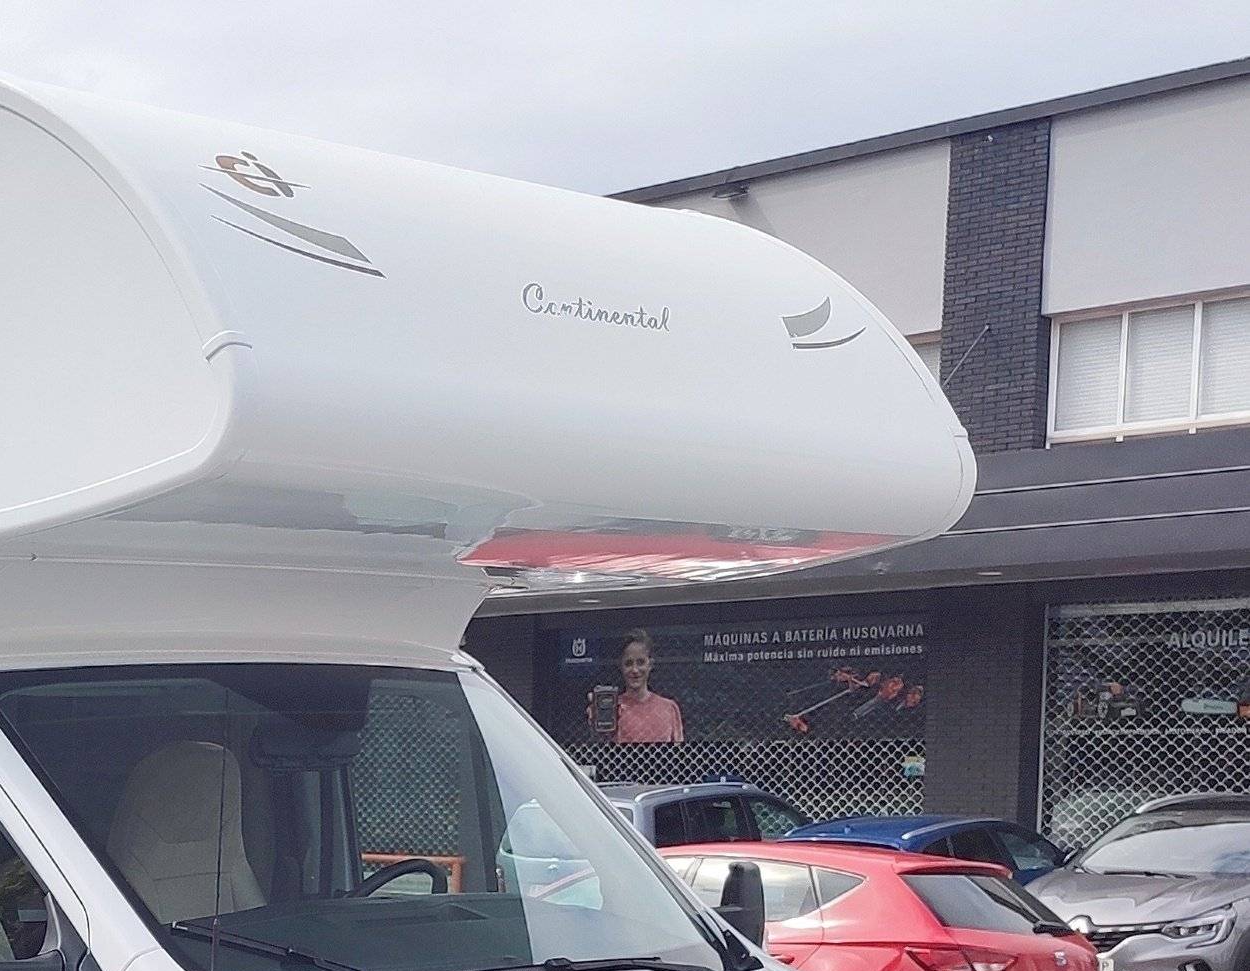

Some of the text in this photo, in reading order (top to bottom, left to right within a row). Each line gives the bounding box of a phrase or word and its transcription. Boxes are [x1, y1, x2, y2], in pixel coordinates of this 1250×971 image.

[523, 283, 670, 331] Continental
[772, 631, 781, 643] A
[785, 627, 838, 642] BATERÍA
[843, 623, 924, 640] HUSQVARNA
[1167, 629, 1250, 649] ALQUILE
[748, 648, 794, 662] potencia
[797, 648, 814, 659] sin
[817, 646, 846, 658] ruido
[850, 645, 861, 656] ni
[864, 643, 923, 656] emisiones
